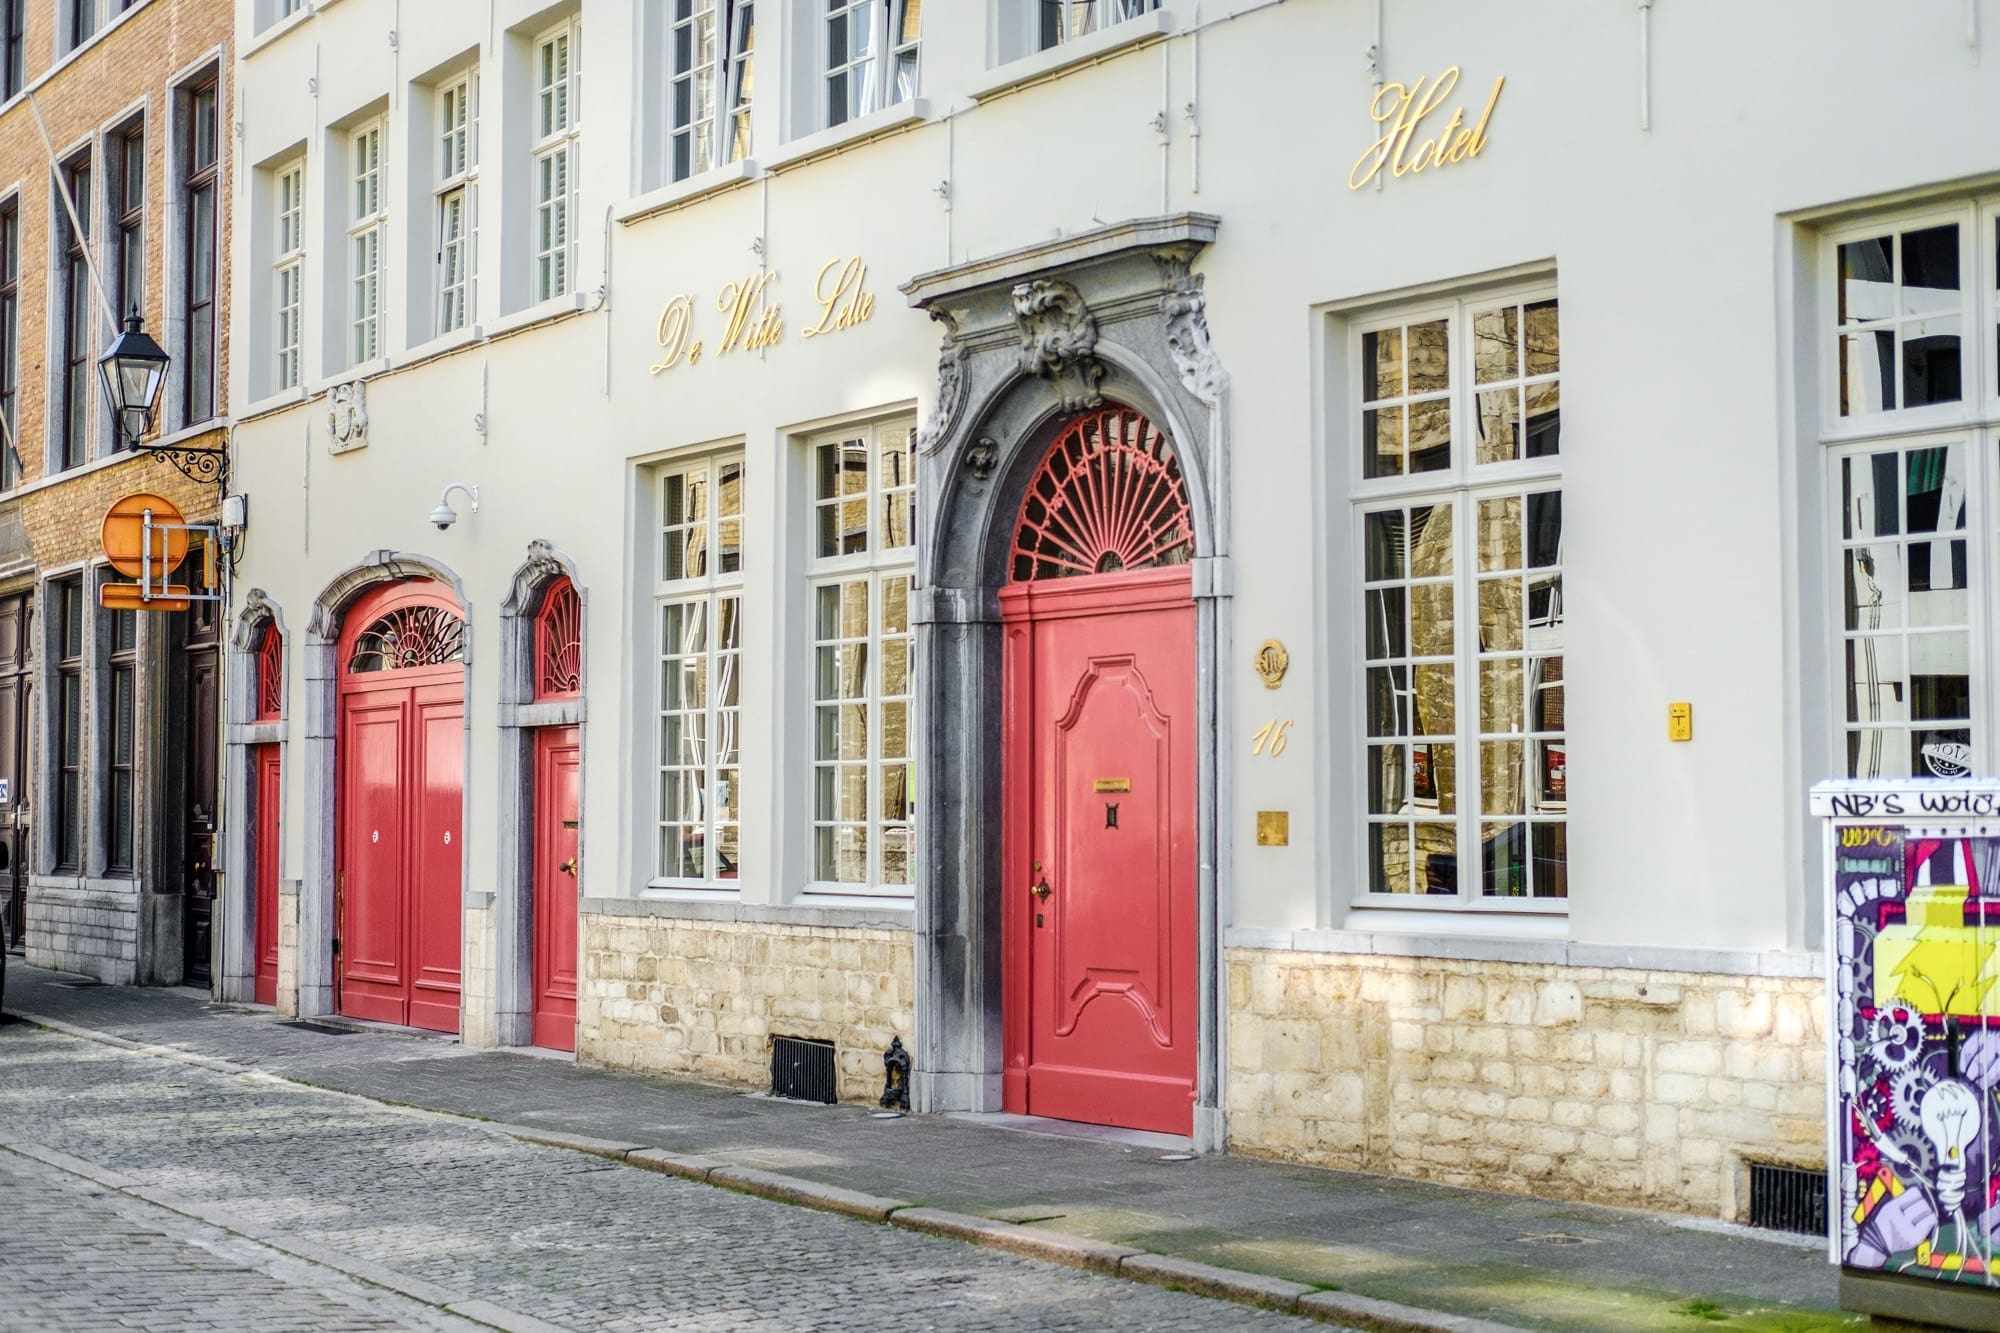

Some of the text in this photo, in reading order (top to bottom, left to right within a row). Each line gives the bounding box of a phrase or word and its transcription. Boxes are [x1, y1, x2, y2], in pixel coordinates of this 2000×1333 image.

[1349, 65, 1504, 190] Hotel
[650, 255, 873, 375] De Witte Lelie
[1252, 719, 1293, 758] 16
